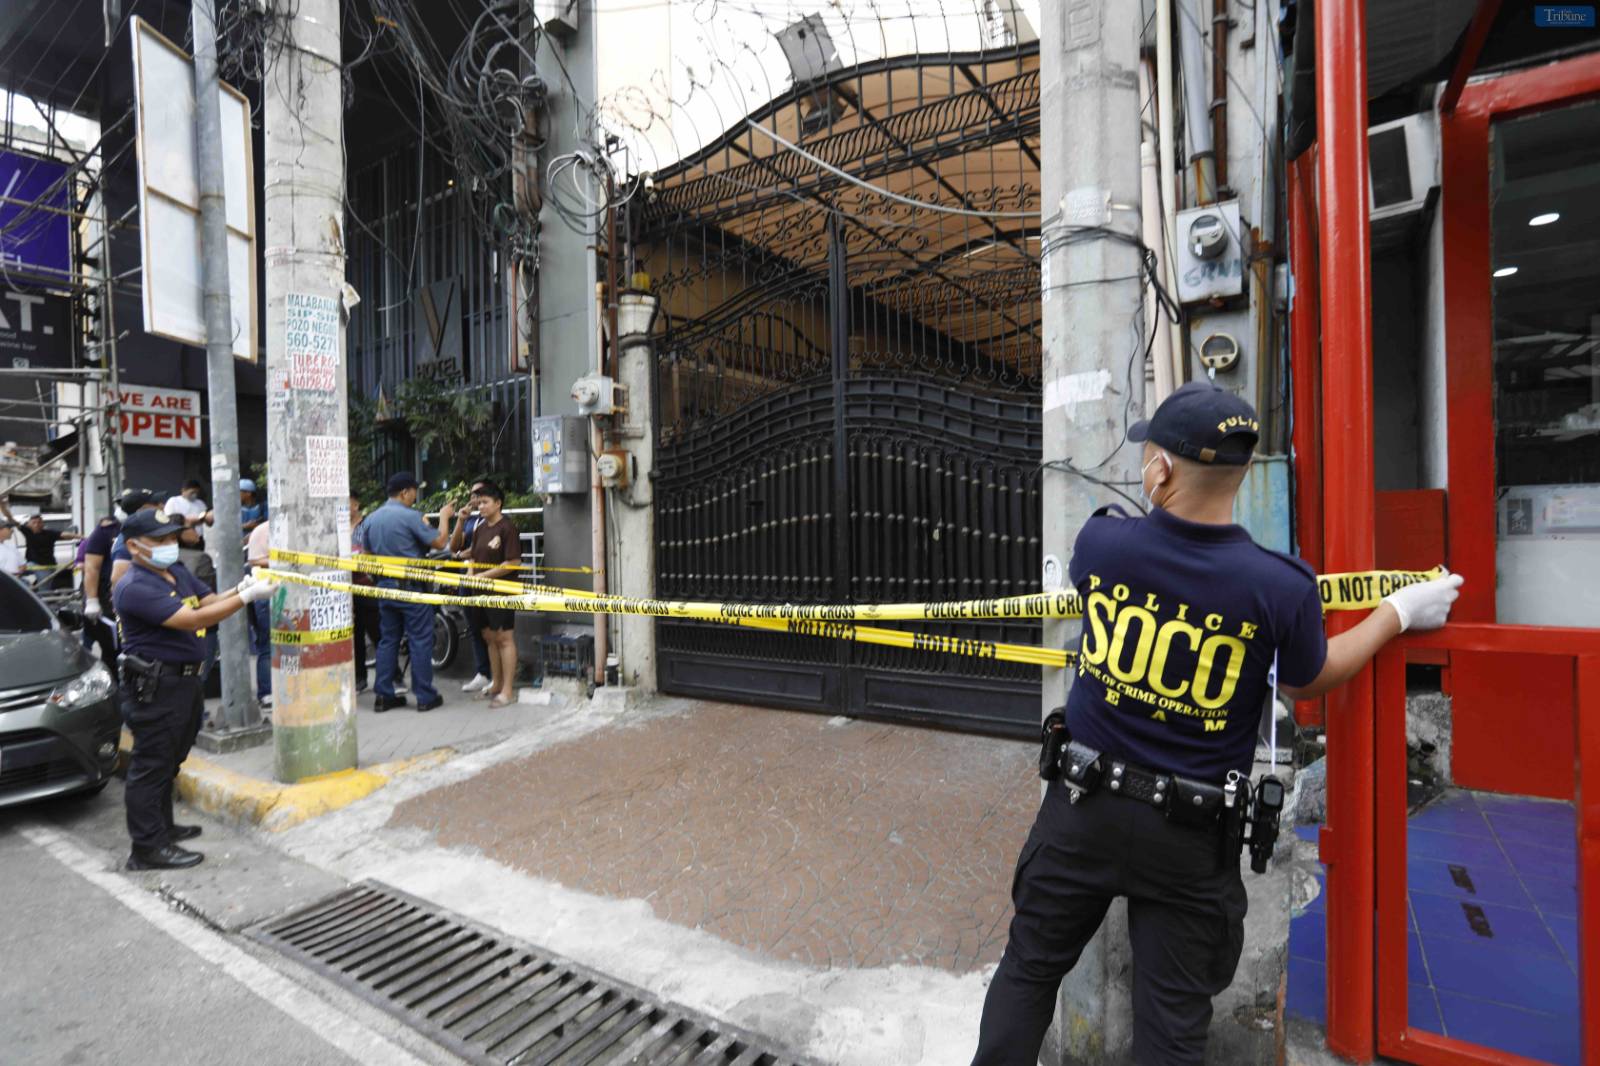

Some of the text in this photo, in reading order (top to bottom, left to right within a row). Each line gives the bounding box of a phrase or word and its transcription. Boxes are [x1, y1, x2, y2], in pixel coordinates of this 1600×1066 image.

[150, 394, 192, 411] ARE
[1339, 576, 1373, 602] NOT
[641, 602, 670, 615] CROSS
[720, 603, 856, 619] POLICE LINE DO NOT CROSS
[924, 593, 1084, 618] POLICE LINE DO NOT CRO
[1089, 574, 1258, 640] POLICE
[1083, 591, 1246, 709] SOCO
[1102, 673, 1116, 687] OF
[1117, 682, 1157, 706] CRIME
[1158, 697, 1229, 718] OPERATION
